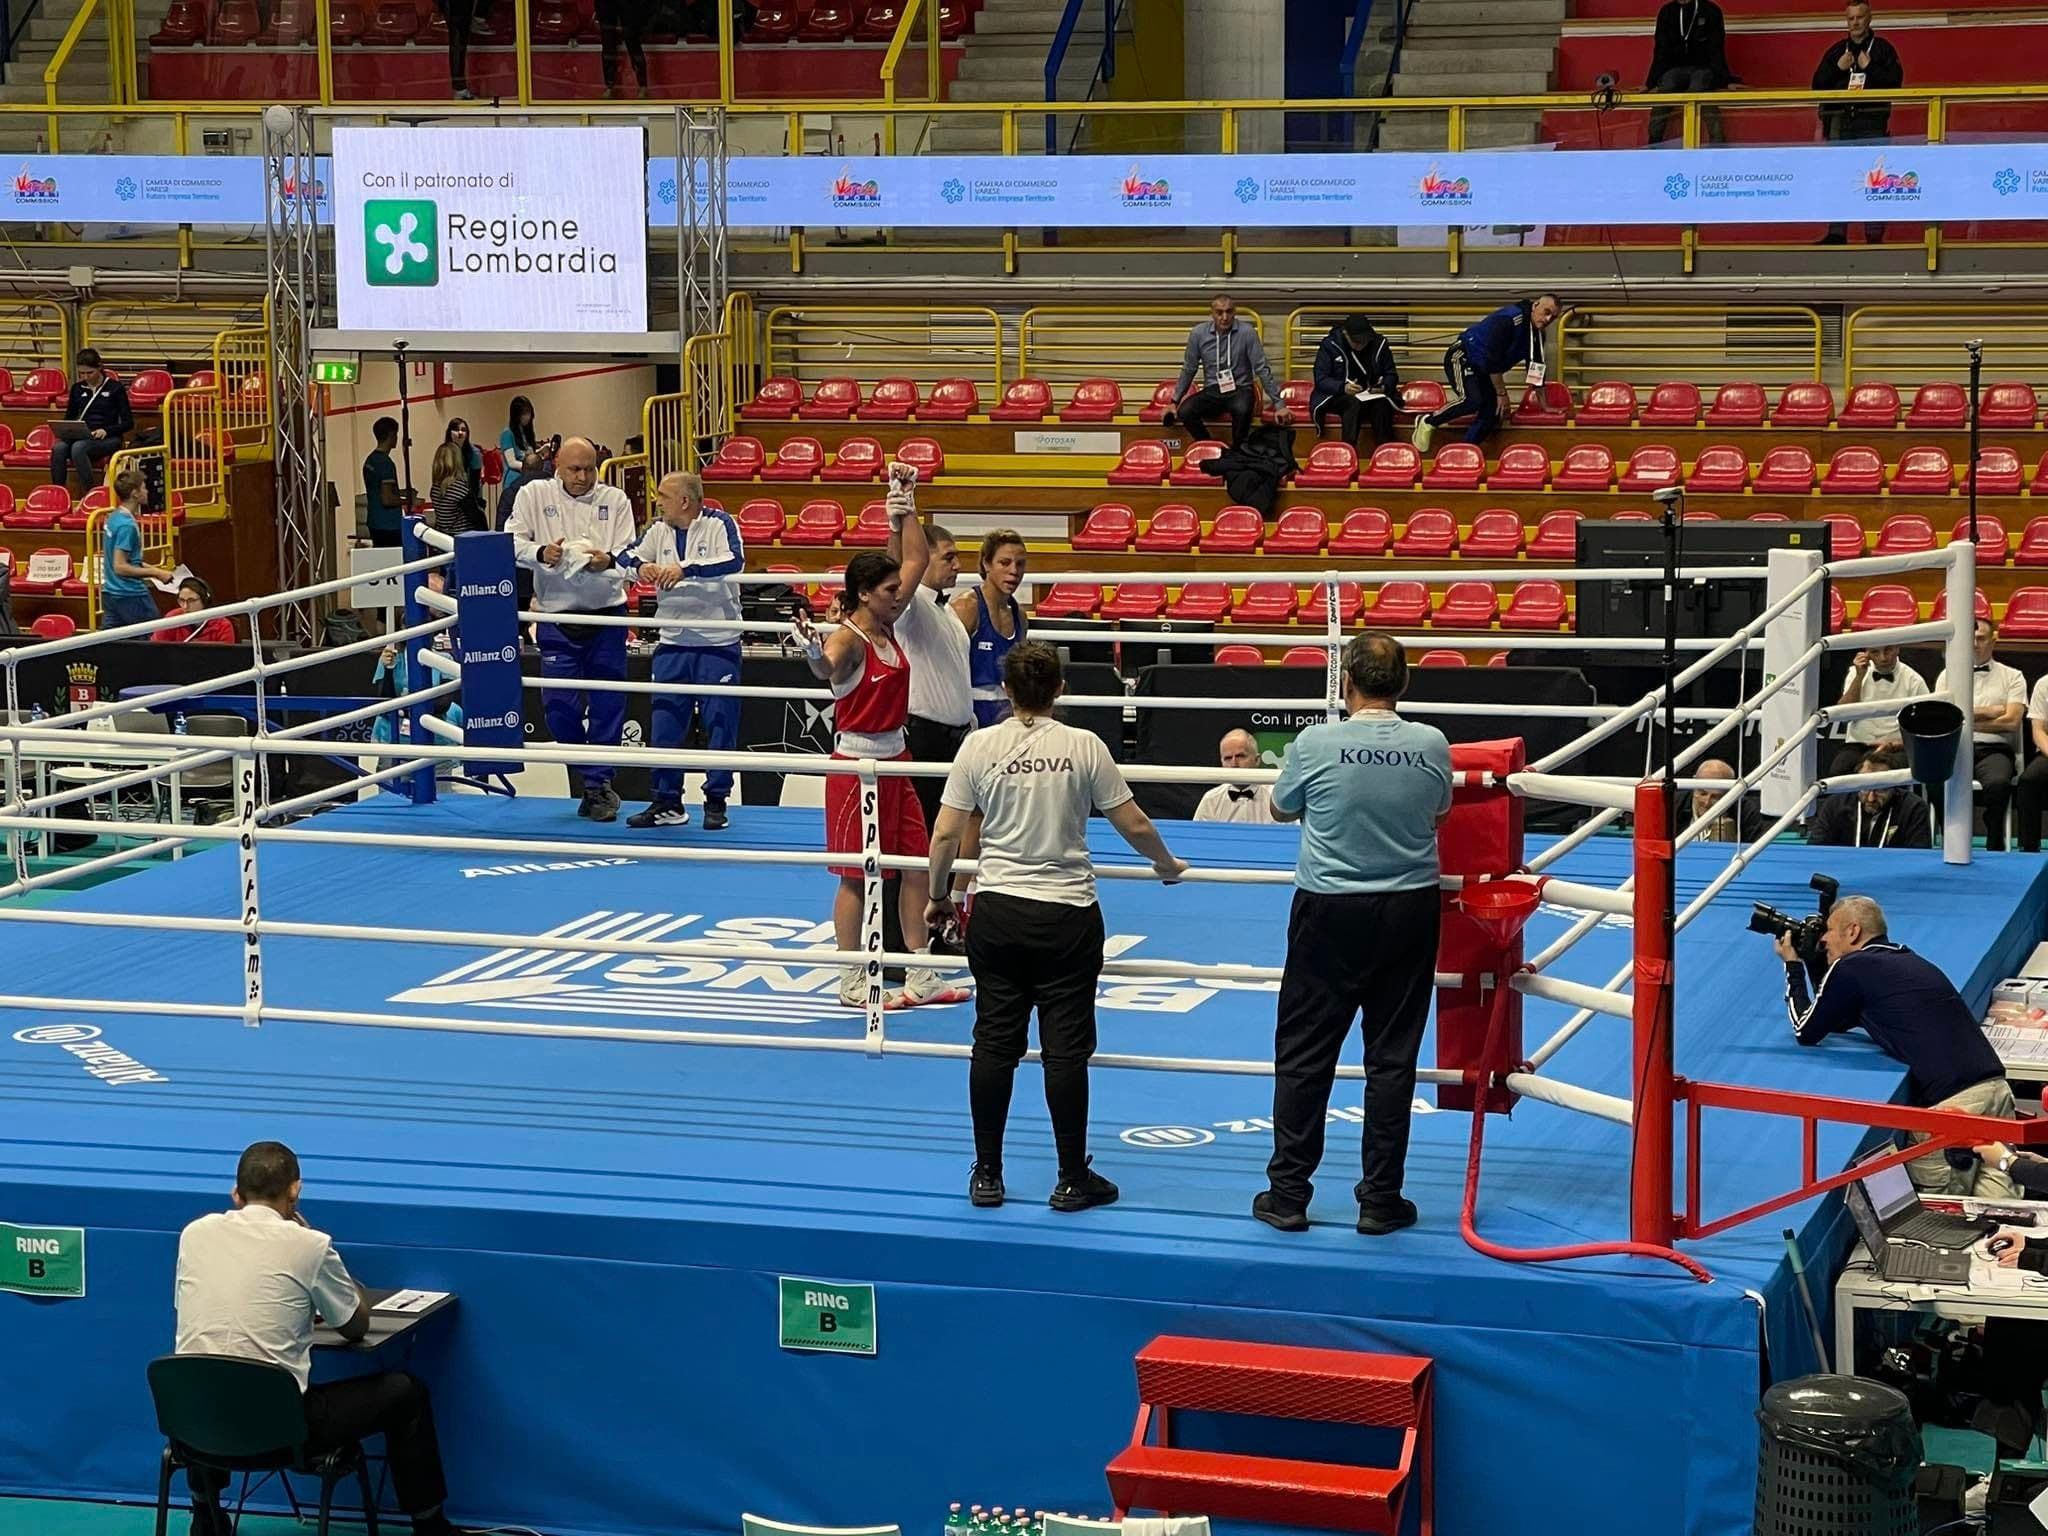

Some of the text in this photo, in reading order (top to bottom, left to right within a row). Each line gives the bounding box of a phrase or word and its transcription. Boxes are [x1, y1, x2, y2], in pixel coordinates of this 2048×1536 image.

[363, 172, 514, 191] Con il patronato di
[1744, 174, 1794, 182] COMMERCIO
[448, 213, 579, 247] Regione
[449, 246, 617, 273] Lombardia
[460, 584, 497, 597] Allianz
[464, 651, 500, 664] Allianz
[467, 717, 503, 730] Allianz
[1251, 712, 1279, 725] Con
[1284, 713, 1291, 725] il
[991, 758, 1074, 776] OSOVA
[1339, 748, 1428, 768] KOSOVA
[459, 857, 639, 878] Allianz
[61, 1040, 170, 1086] Allianz
[16, 1236, 60, 1255] RING
[28, 1258, 46, 1278] B
[804, 1290, 849, 1311] RING
[820, 1312, 837, 1333] B
